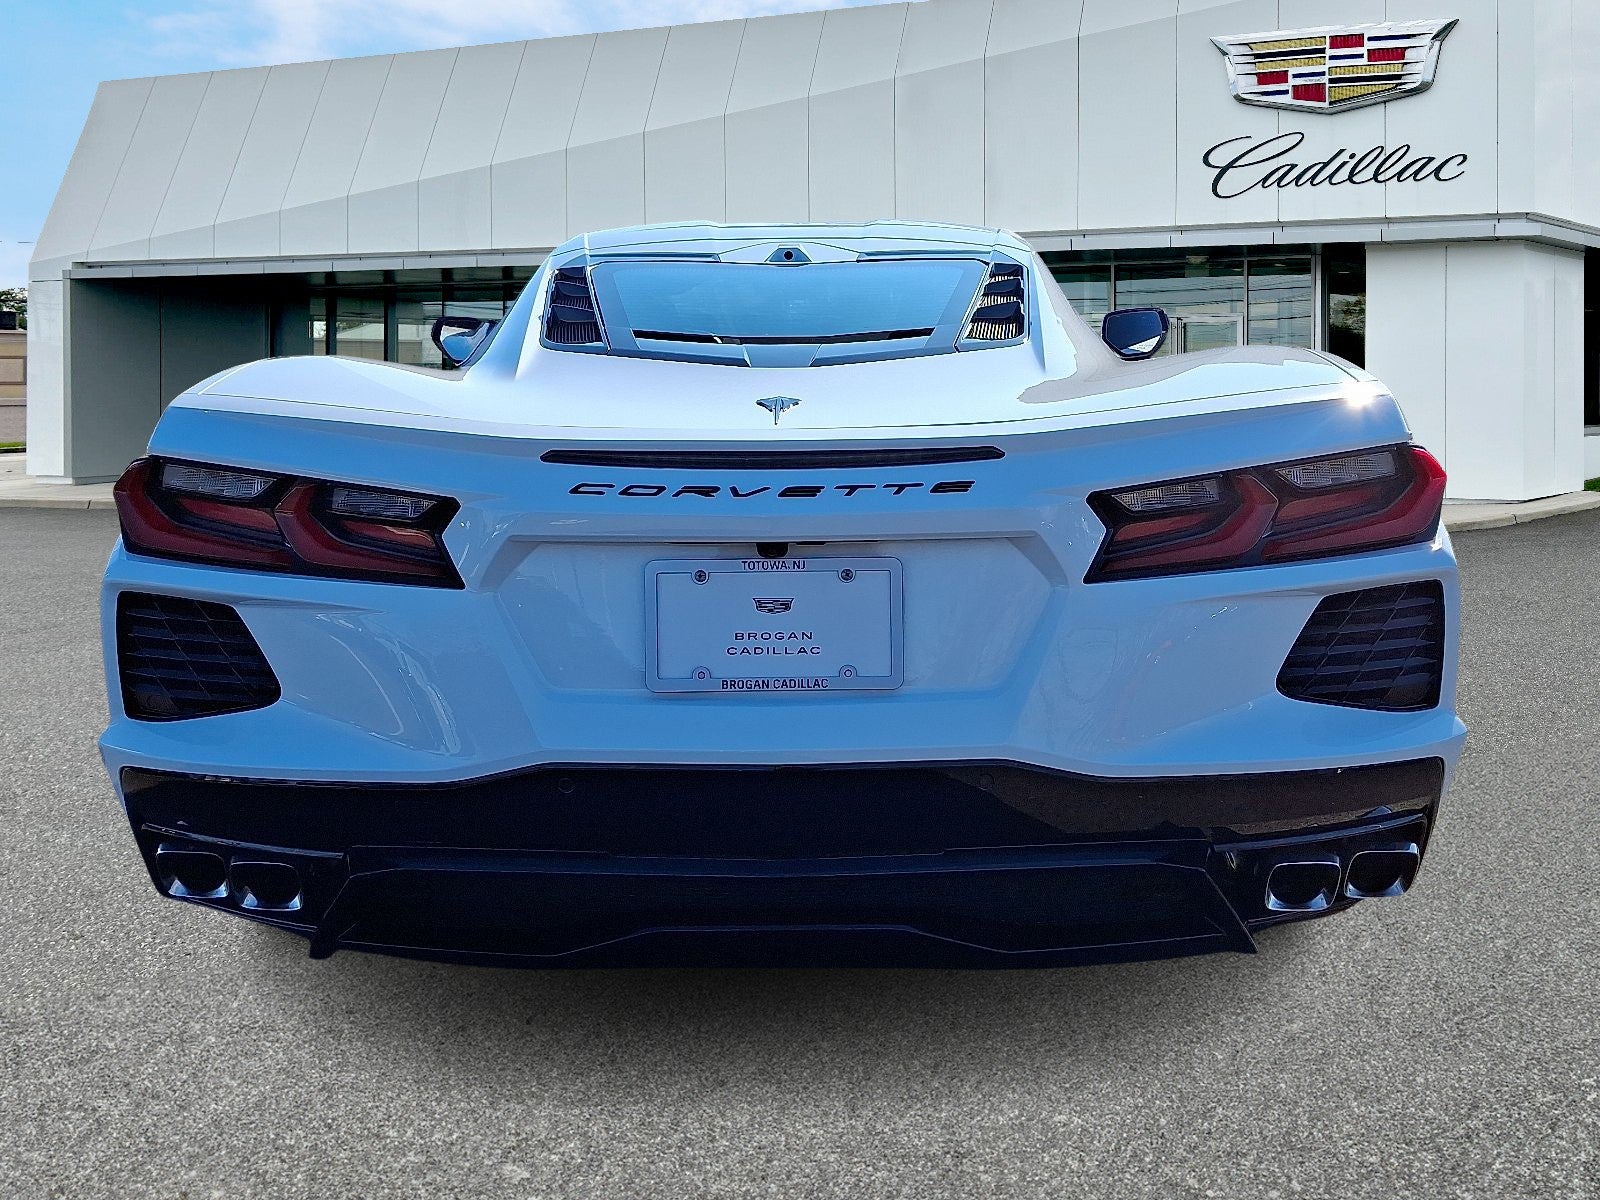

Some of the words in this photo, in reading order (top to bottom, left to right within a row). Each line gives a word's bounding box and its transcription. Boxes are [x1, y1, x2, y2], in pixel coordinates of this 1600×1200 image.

[1202, 131, 1468, 199] Cadillac
[568, 481, 976, 498] CORVETTE
[793, 560, 806, 570] NJ
[734, 632, 813, 641] BROGAN
[726, 646, 821, 655] CADILLAC
[721, 680, 770, 690] BROGAN
[773, 678, 829, 689] CADILLAC
